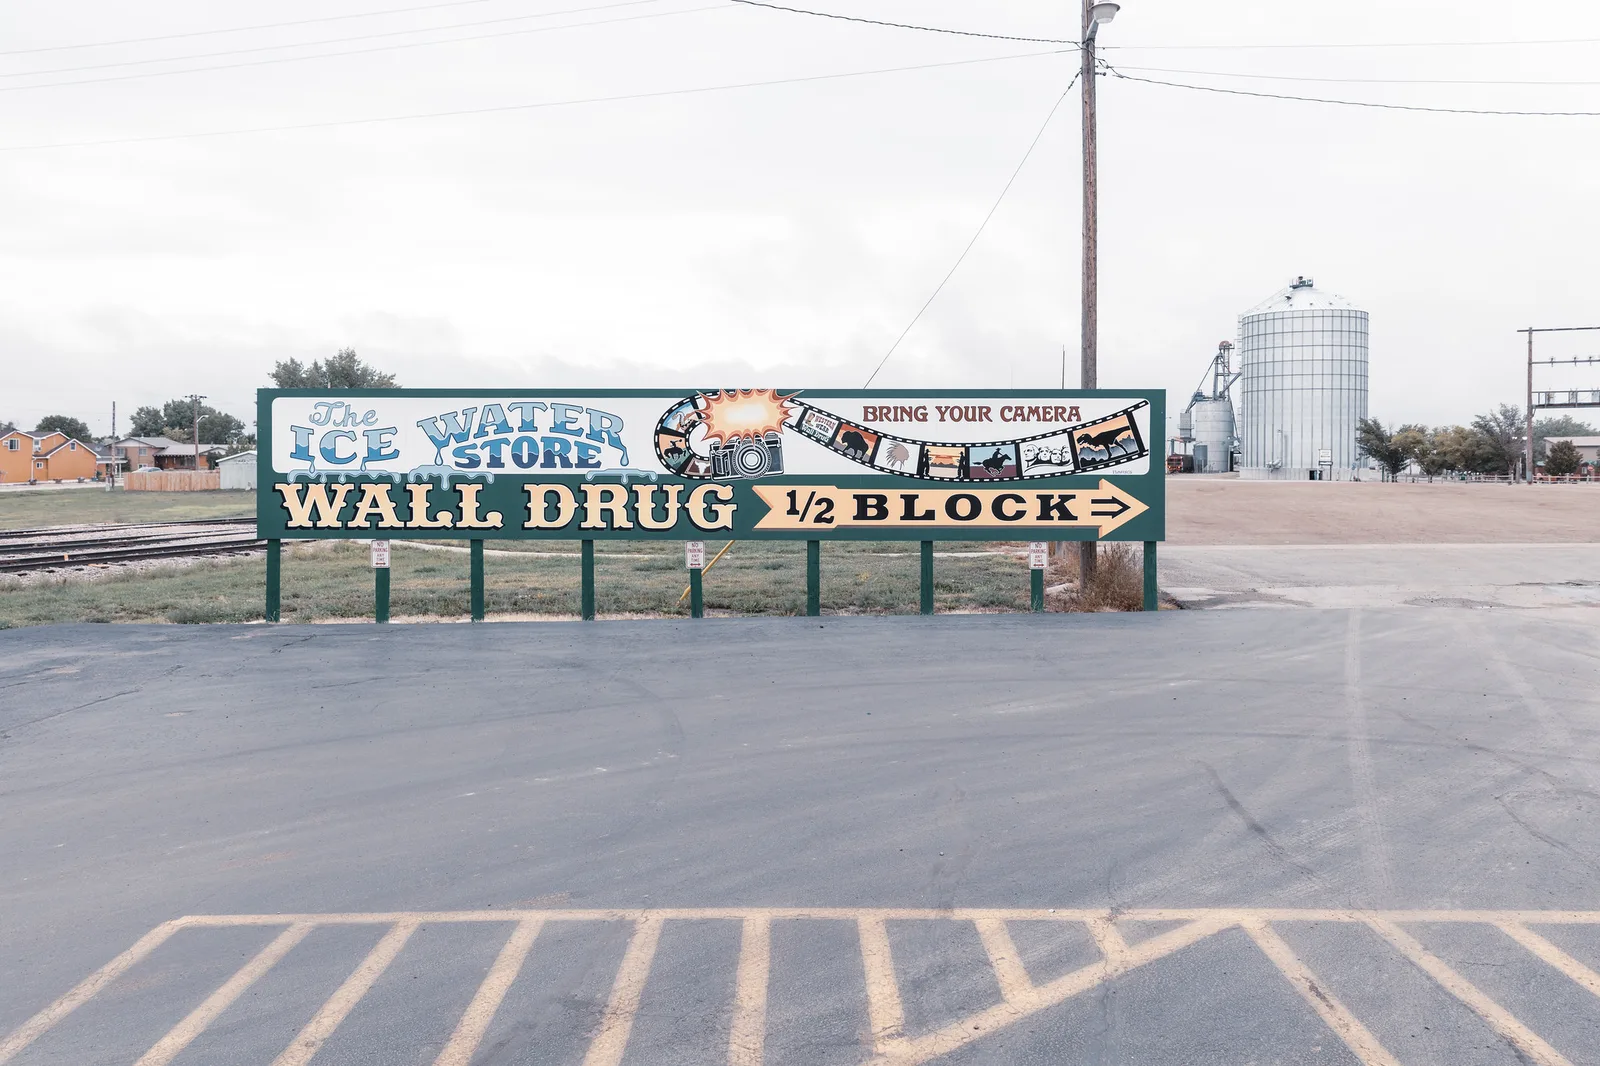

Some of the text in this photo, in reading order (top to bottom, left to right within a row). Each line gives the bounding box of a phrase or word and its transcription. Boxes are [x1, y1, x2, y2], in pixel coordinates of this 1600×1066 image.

[309, 401, 378, 427] The
[416, 401, 628, 452] WATER
[862, 405, 1082, 423] BRING YOUR CAMERA
[290, 425, 400, 465] ICE
[452, 435, 601, 469] STORE
[274, 482, 737, 531] WALL DRUG
[785, 489, 1078, 524] 1/2 BLOCK
